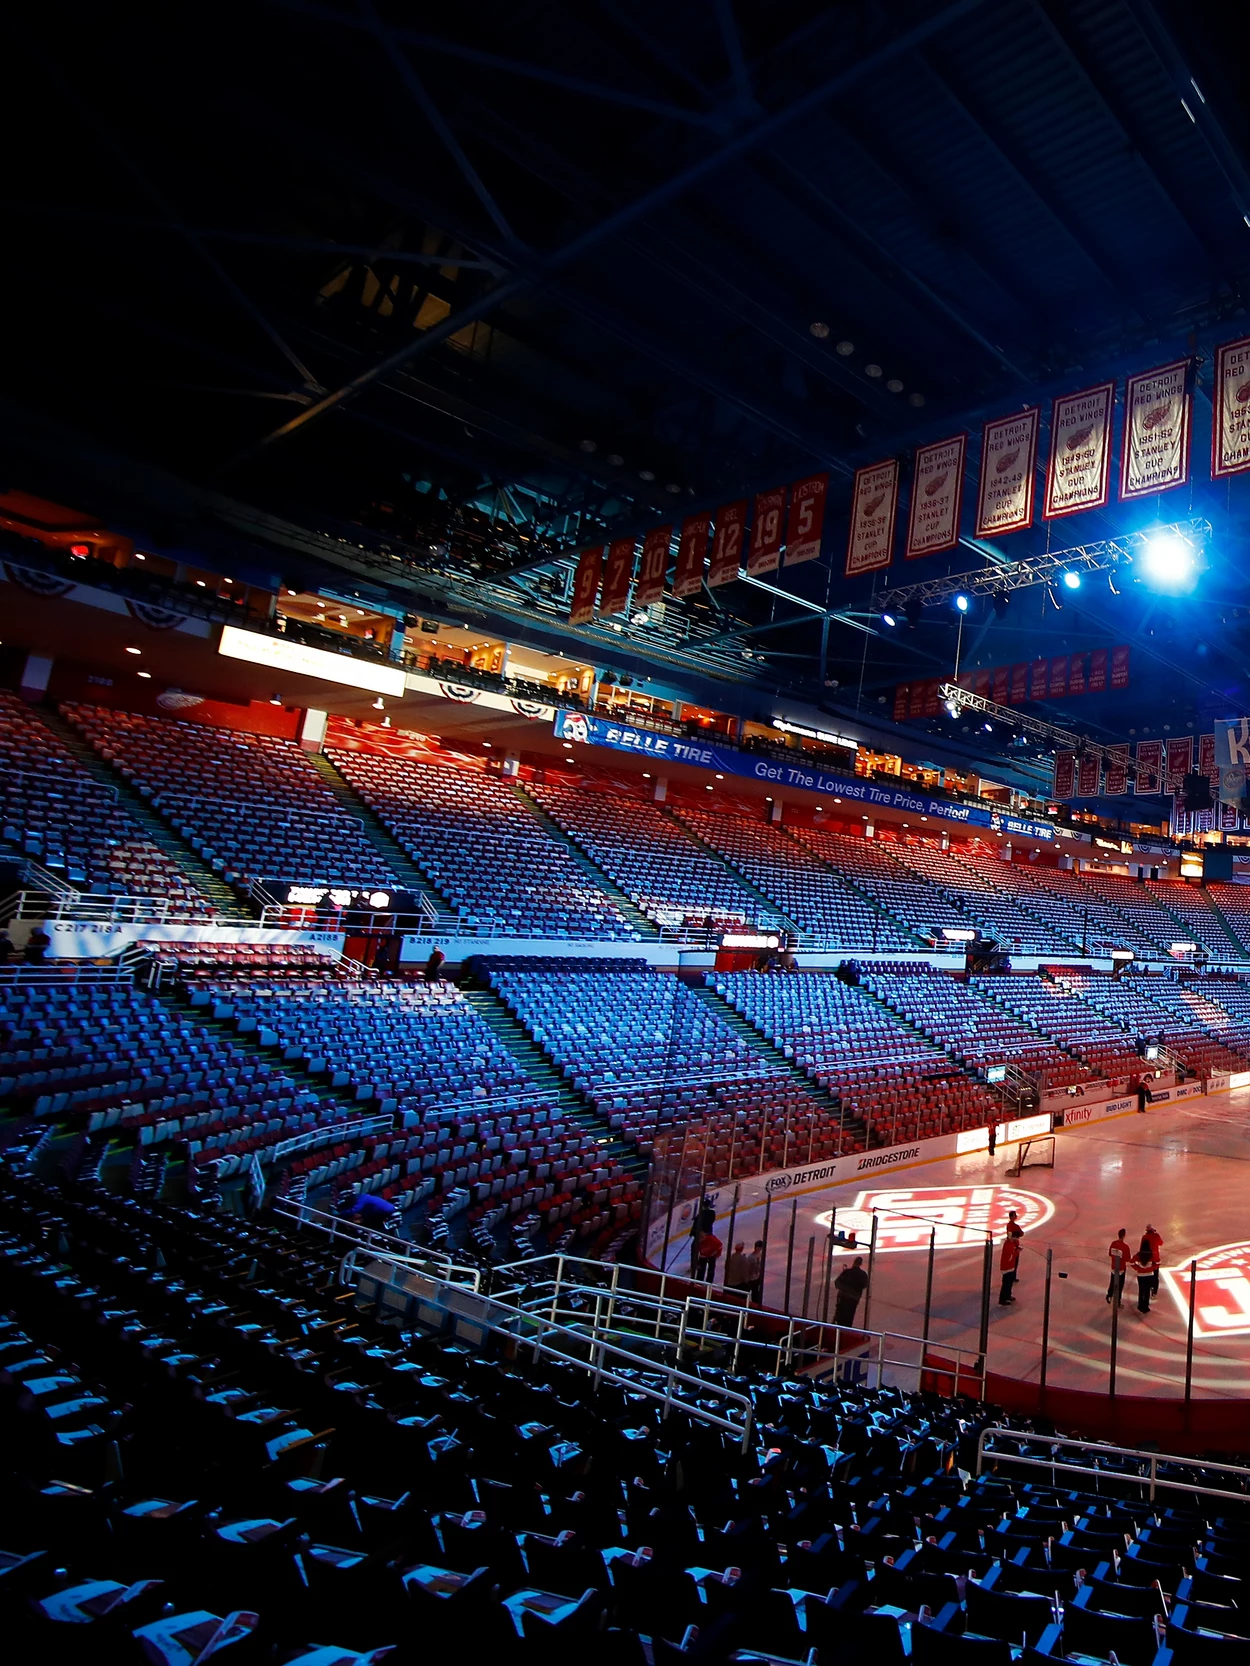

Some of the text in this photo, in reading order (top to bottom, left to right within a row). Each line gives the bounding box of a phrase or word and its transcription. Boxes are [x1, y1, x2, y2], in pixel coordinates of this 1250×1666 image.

[1225, 366, 1244, 378] RED
[1140, 374, 1178, 392] DETROIT
[1134, 385, 1182, 405] RED WINGS
[1065, 399, 1100, 415] DETROIT
[1060, 408, 1104, 428] RED WINGS
[1135, 441, 1176, 459] STANLEY
[1059, 461, 1095, 477] STANLEY
[1145, 458, 1163, 469] CUP
[1068, 476, 1084, 487] CUP
[1129, 466, 1178, 486] CHAMPIONS
[1053, 485, 1098, 503] CHAMPIONS
[798, 498, 814, 534] 5
[754, 510, 779, 548] 19
[716, 523, 740, 560] 12
[686, 538, 696, 570] 1
[609, 559, 625, 590] 7
[642, 548, 664, 581] 10
[580, 569, 593, 598] 9
[605, 728, 713, 763] BELLE TIRE
[754, 762, 970, 820] Get The Lowest Tire Price, Period!
[1007, 821, 1052, 838] BELLE TIRE
[433, 937, 450, 945] 219
[1177, 1089, 1187, 1097] DMC
[1065, 1108, 1092, 1124] xfinity
[1106, 1101, 1132, 1112] BUD LIGHT
[858, 1148, 919, 1170] BRIDGESTONE
[770, 1166, 836, 1187] FOX DETROIT
